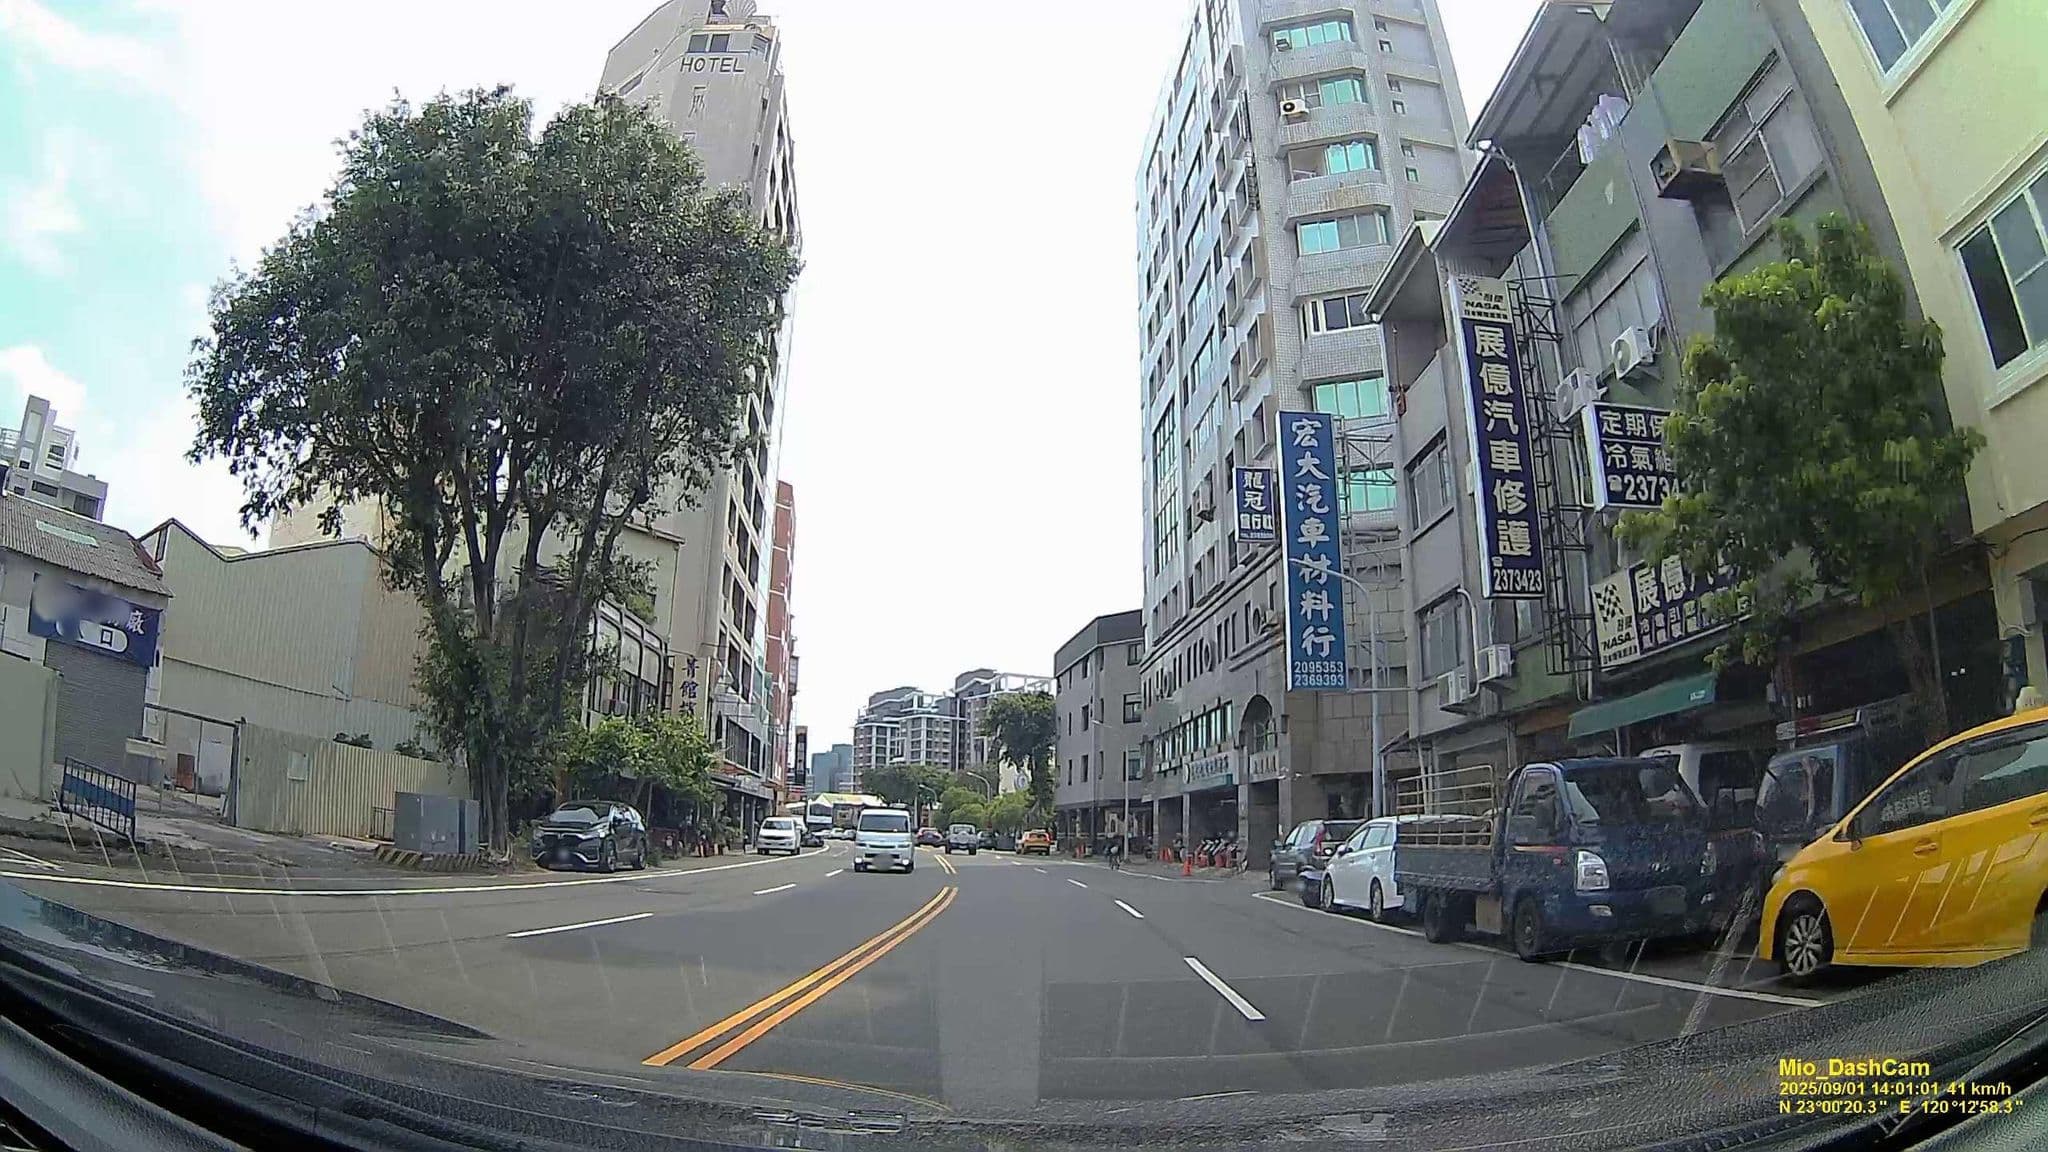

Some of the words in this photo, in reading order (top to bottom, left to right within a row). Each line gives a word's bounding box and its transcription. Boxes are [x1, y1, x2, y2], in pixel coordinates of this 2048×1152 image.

[680, 57, 744, 73] HOTEL
[1474, 325, 1531, 556] 展億汽車修護
[1291, 418, 1335, 658] 宏大汽車材料行
[1493, 569, 1543, 592] 2373423
[1601, 631, 1633, 651] NASA
[1294, 661, 1344, 673] 2095353
[1294, 674, 1345, 686] 2369393
